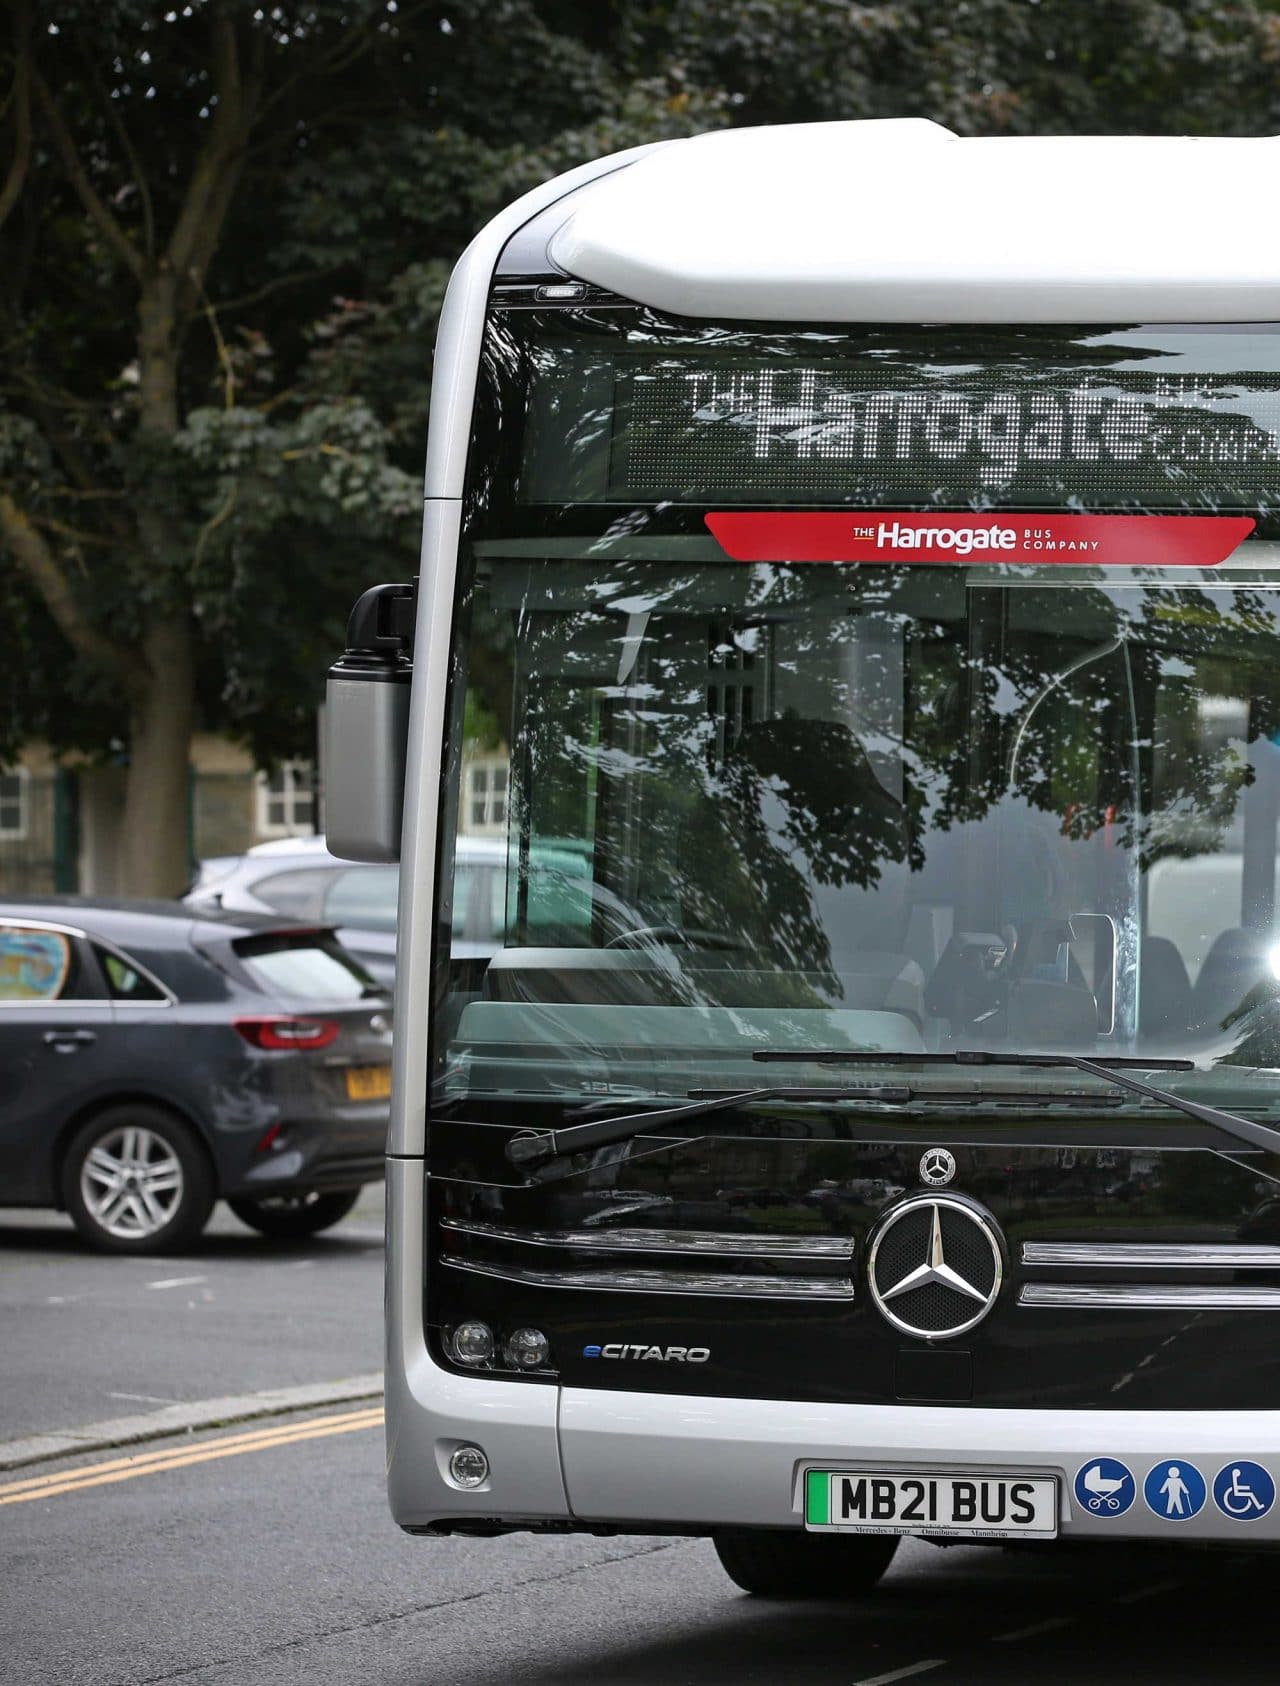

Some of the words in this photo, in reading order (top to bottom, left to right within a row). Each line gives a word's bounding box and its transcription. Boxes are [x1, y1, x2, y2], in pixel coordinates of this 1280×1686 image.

[684, 373, 755, 413] THE
[755, 367, 1149, 485] Harrogate
[853, 526, 876, 538] THE
[876, 521, 1017, 555] Harrogate
[1023, 529, 1052, 540] BUS
[1022, 540, 1100, 551] COMPANY
[582, 1343, 711, 1363] eCITARO
[840, 1477, 938, 1522] MB21
[950, 1482, 1036, 1525] BUS
